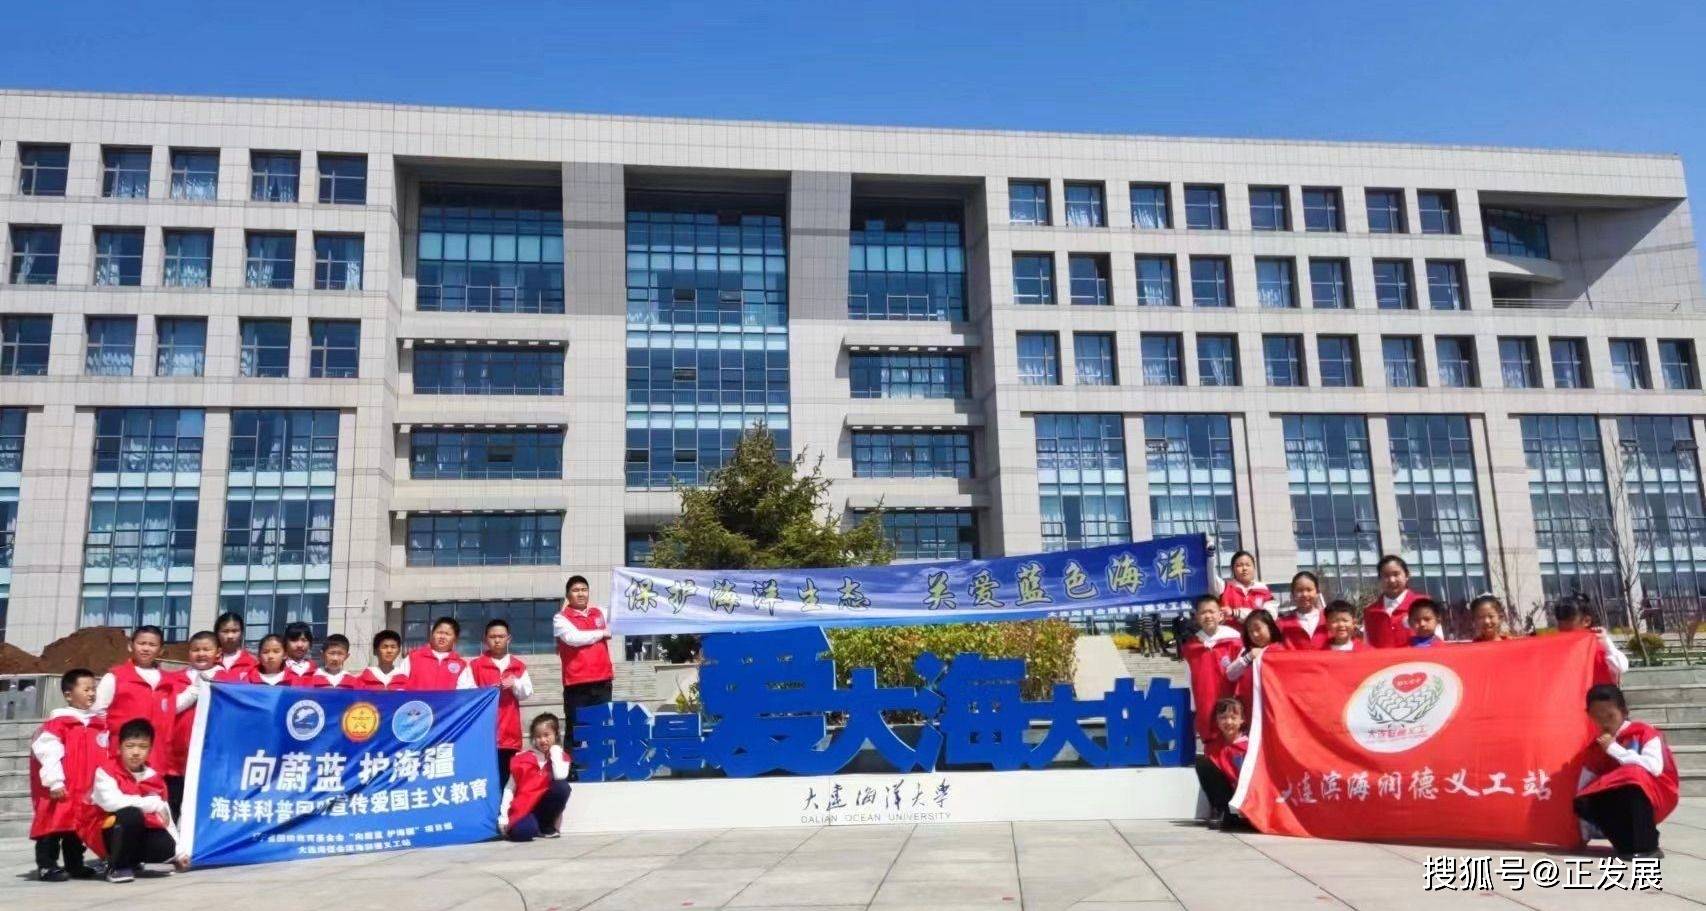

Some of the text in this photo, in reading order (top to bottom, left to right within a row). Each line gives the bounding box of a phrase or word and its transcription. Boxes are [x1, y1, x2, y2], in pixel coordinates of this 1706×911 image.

[625, 548, 1192, 617] 保护海洋生态 关爱蓝色海洋
[570, 625, 1197, 782] 我是爱大海大的
[240, 743, 456, 792] 向蔚蓝 护海疆
[801, 812, 952, 824] DALIAN OCEAN UNIVERSITY
